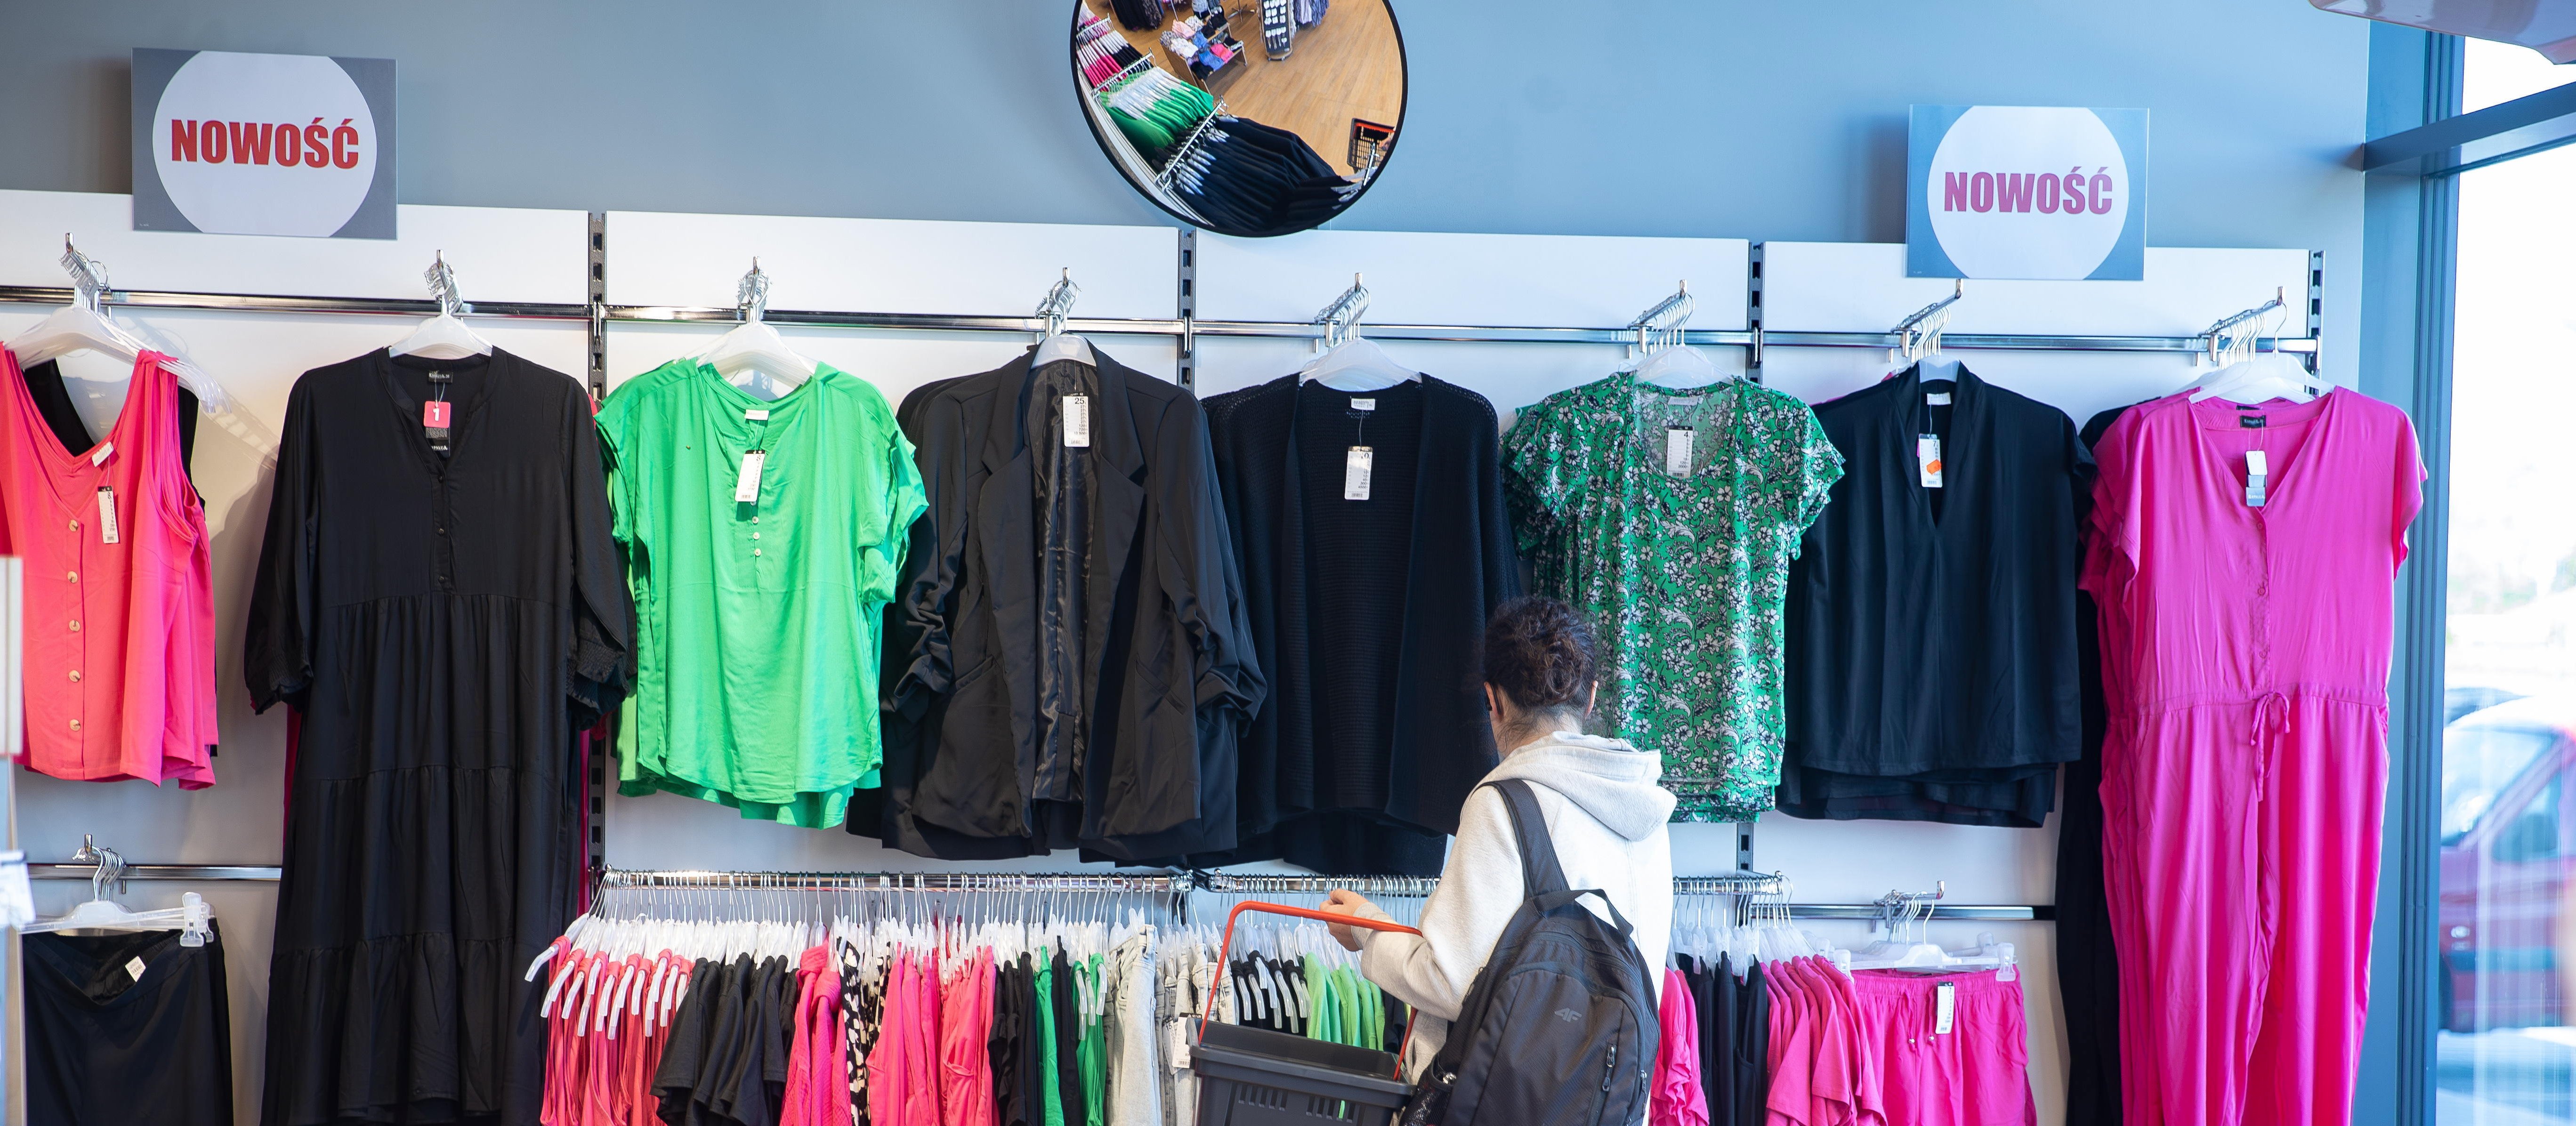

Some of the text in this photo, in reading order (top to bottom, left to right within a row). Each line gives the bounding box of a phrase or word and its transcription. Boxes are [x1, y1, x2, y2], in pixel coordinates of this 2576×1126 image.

[172, 117, 359, 169] NOWOŚĆ
[1944, 166, 2113, 215] NOWOŚĆ
[433, 408, 440, 421] 1
[1554, 1007, 1582, 1023] 4F
